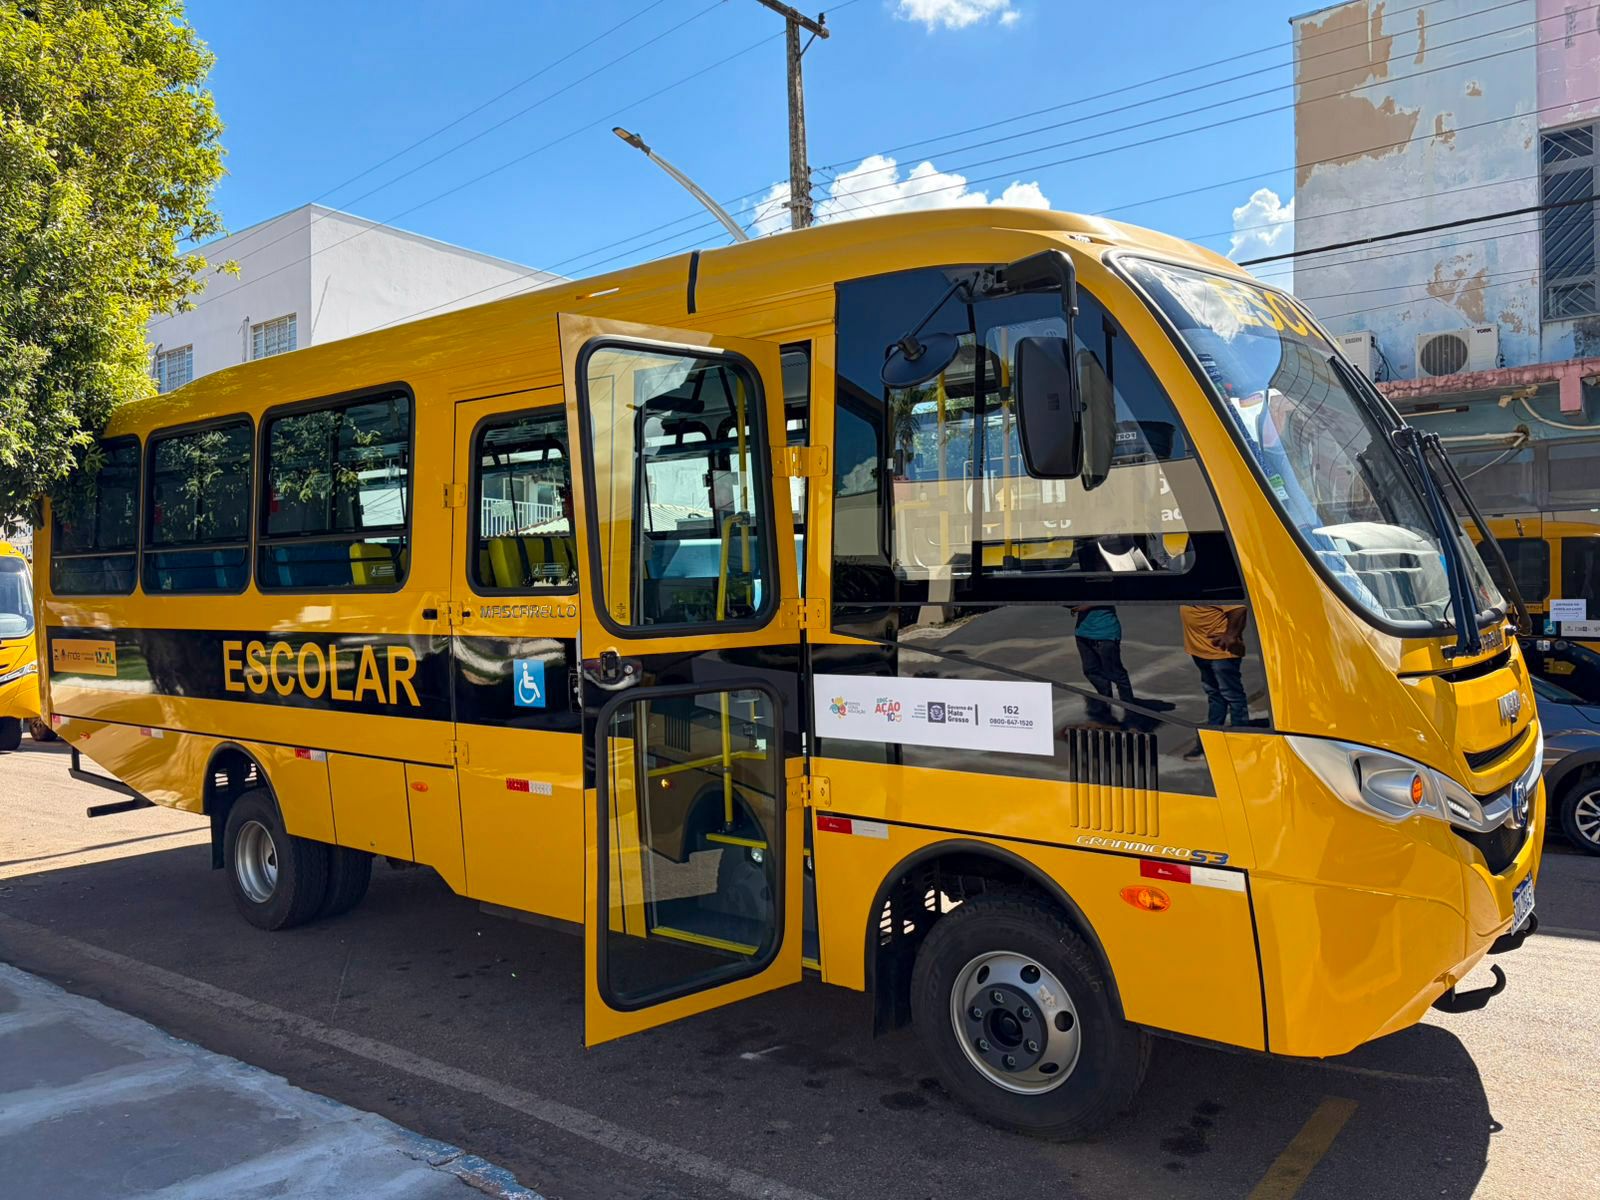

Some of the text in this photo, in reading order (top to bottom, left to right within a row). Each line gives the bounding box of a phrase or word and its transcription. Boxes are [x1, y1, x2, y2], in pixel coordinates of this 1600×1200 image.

[479, 604, 577, 619] MASCARELLO
[222, 640, 421, 707] ESCOLAR
[947, 709, 964, 717] Mato
[1002, 705, 1020, 716] 162
[947, 715, 970, 724] Grosso
[989, 718, 1034, 727] 0800-647-1520
